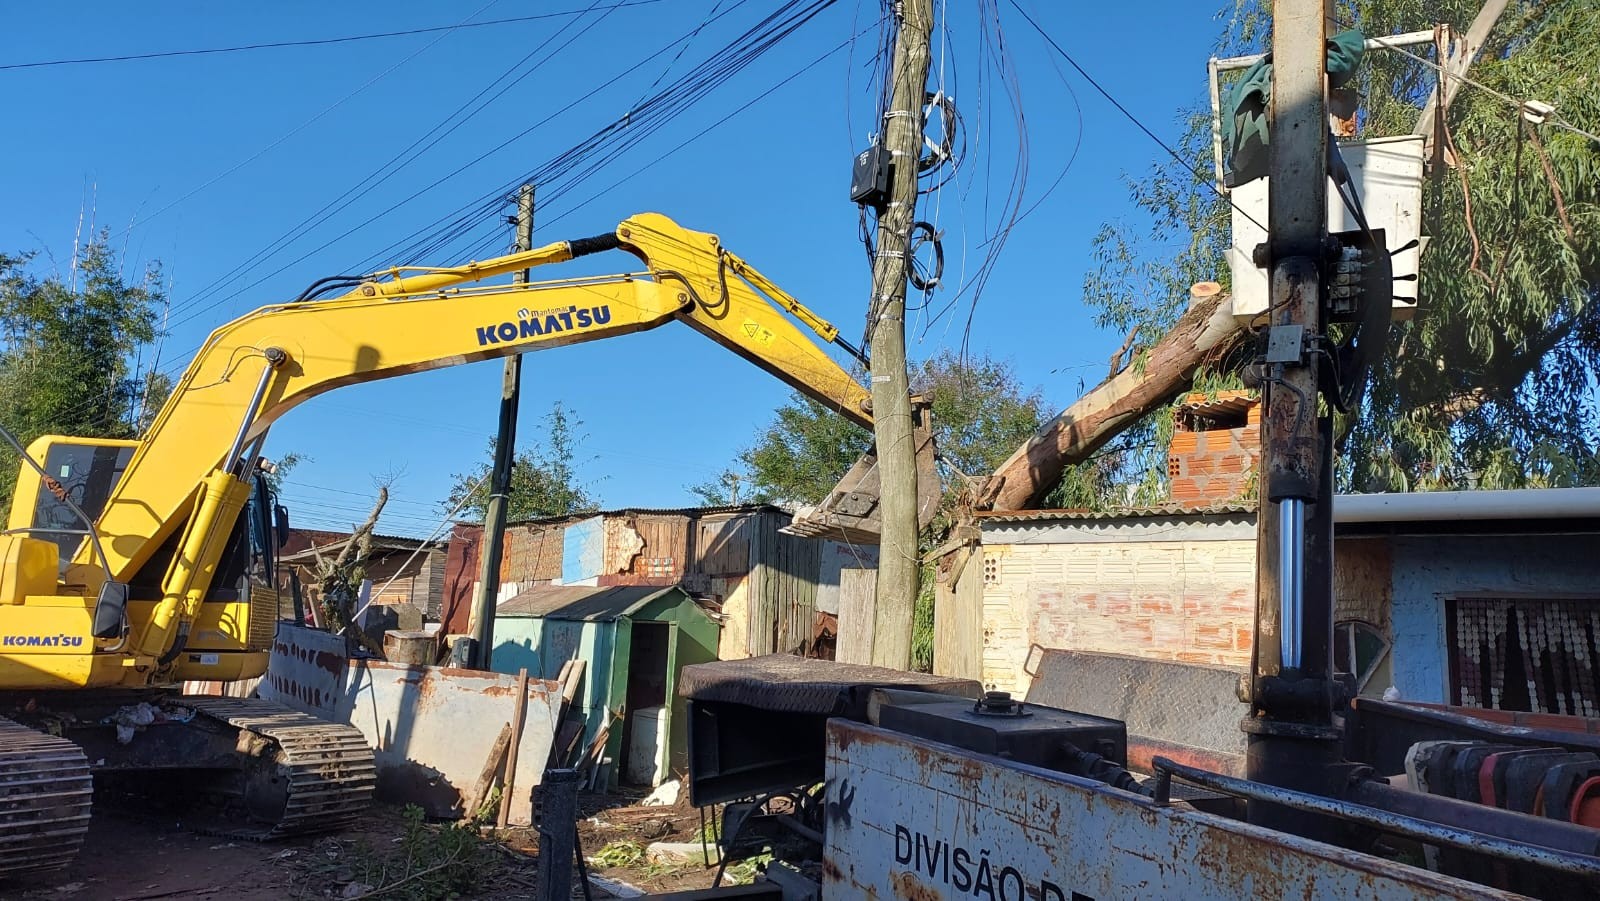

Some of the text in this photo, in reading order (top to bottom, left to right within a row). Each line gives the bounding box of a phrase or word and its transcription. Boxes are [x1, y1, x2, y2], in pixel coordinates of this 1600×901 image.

[477, 305, 611, 345] KOMATSU
[3, 634, 83, 647] KOMATSU
[895, 824, 1024, 901] DIVISÃO
